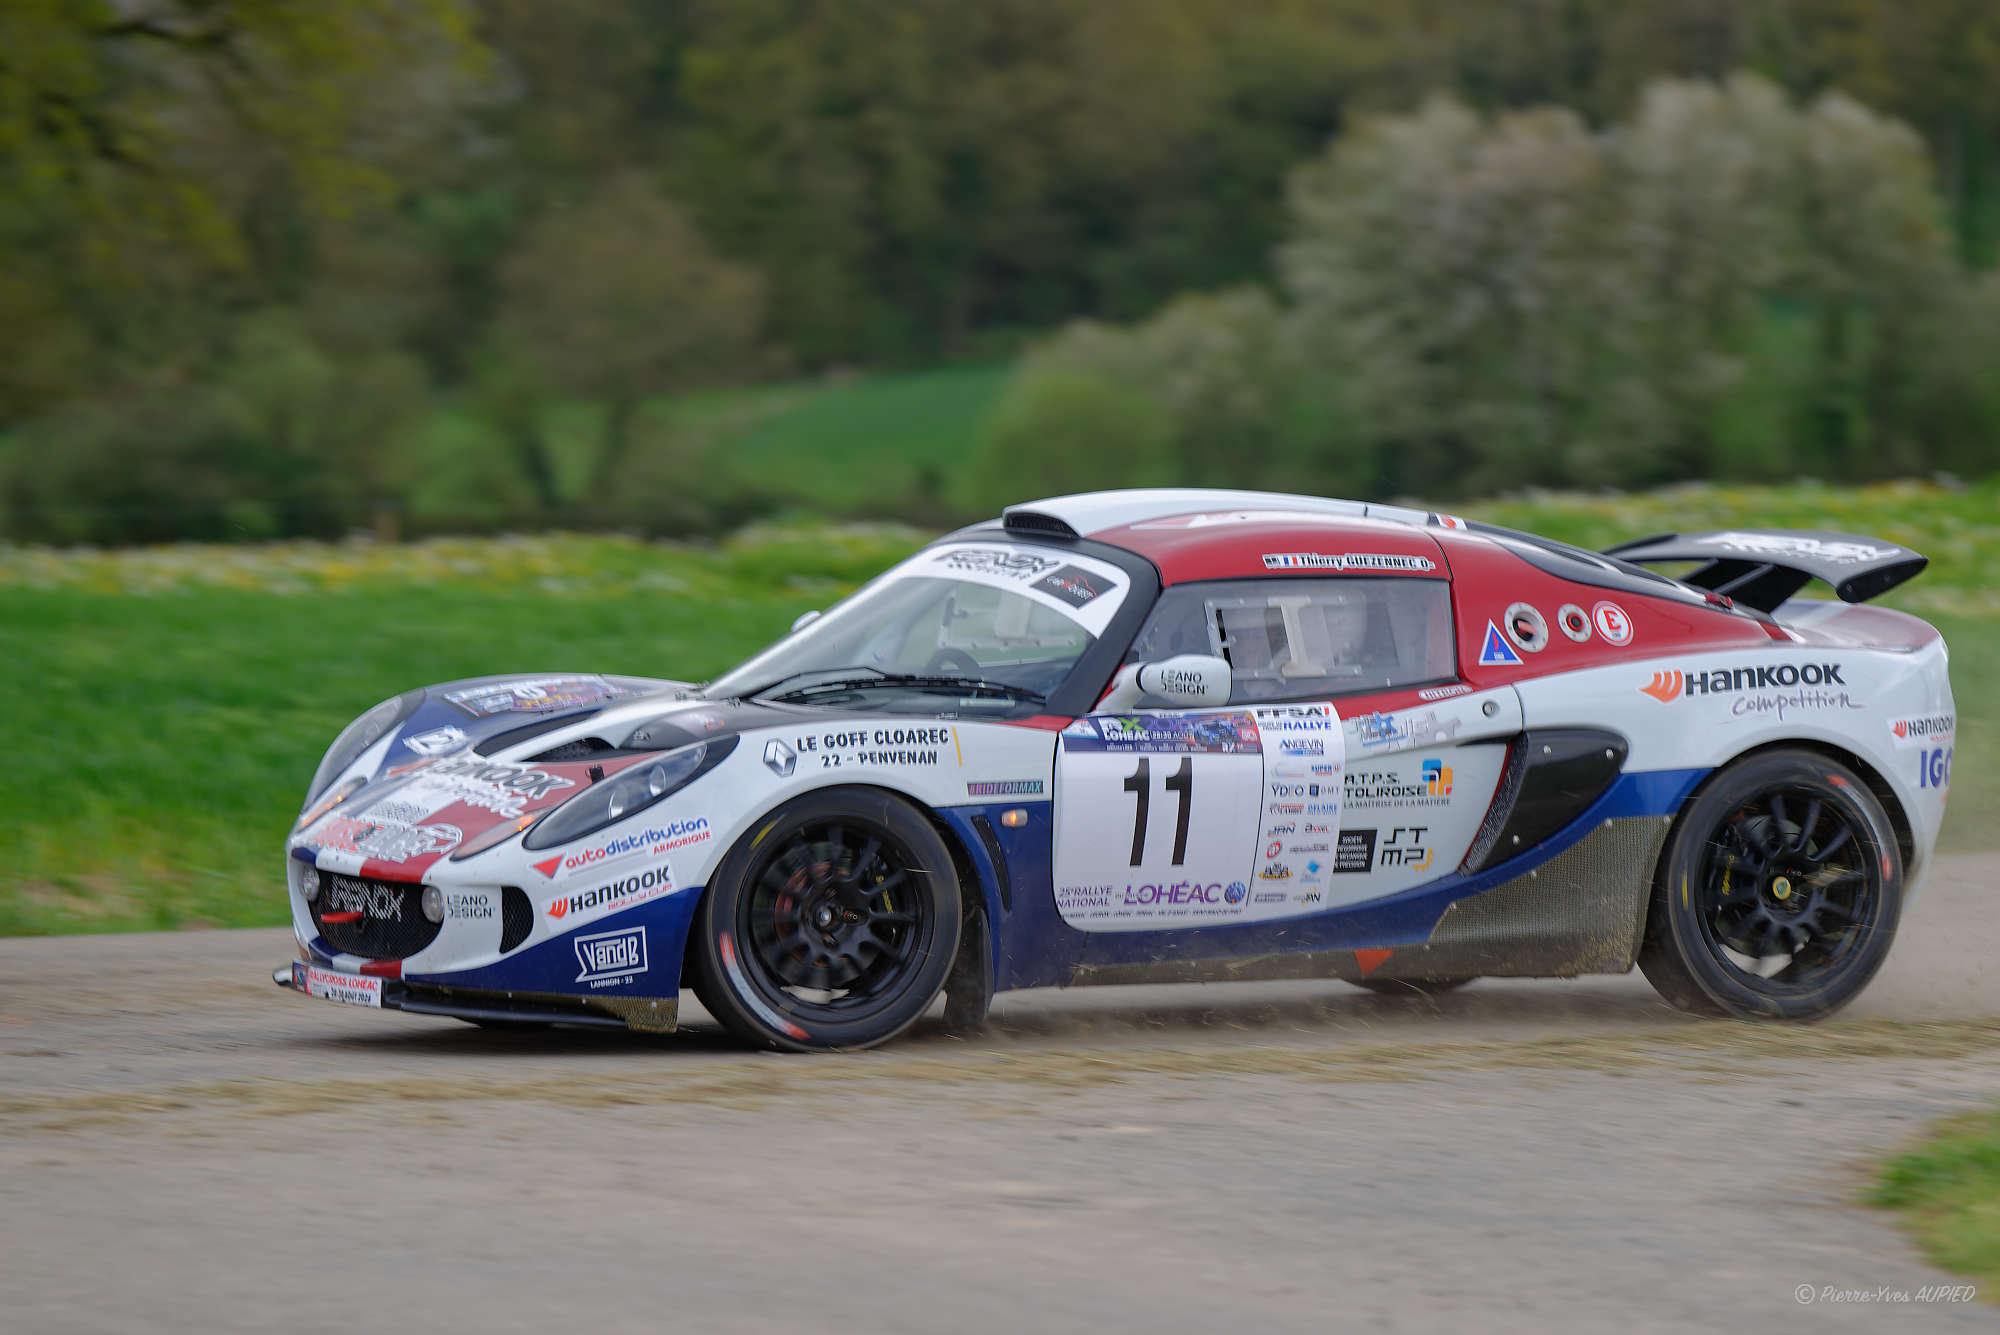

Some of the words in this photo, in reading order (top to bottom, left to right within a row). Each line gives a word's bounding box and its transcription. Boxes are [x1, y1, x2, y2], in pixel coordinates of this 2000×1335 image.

[1301, 555, 1342, 568] Thierry
[1346, 555, 1417, 569] GUEZENNEC
[1603, 609, 1622, 631] E
[1160, 670, 1202, 683] LEANO
[1684, 663, 1846, 697] HANKOOK
[1256, 706, 1322, 718] FFSA
[1283, 721, 1332, 731] RALLYE
[796, 735, 818, 752] LE
[823, 730, 868, 749] GOFF
[873, 727, 949, 745] CLOAREC
[820, 754, 842, 768] 22
[857, 750, 938, 766] PENVENAN
[1123, 756, 1194, 867] 11
[565, 817, 708, 869] autodistribution
[652, 830, 712, 856] ARMORIQUE
[569, 864, 670, 913] HANKOOK
[1123, 879, 1222, 905] LOHÉAC
[1056, 897, 1110, 908] NATIONAL
